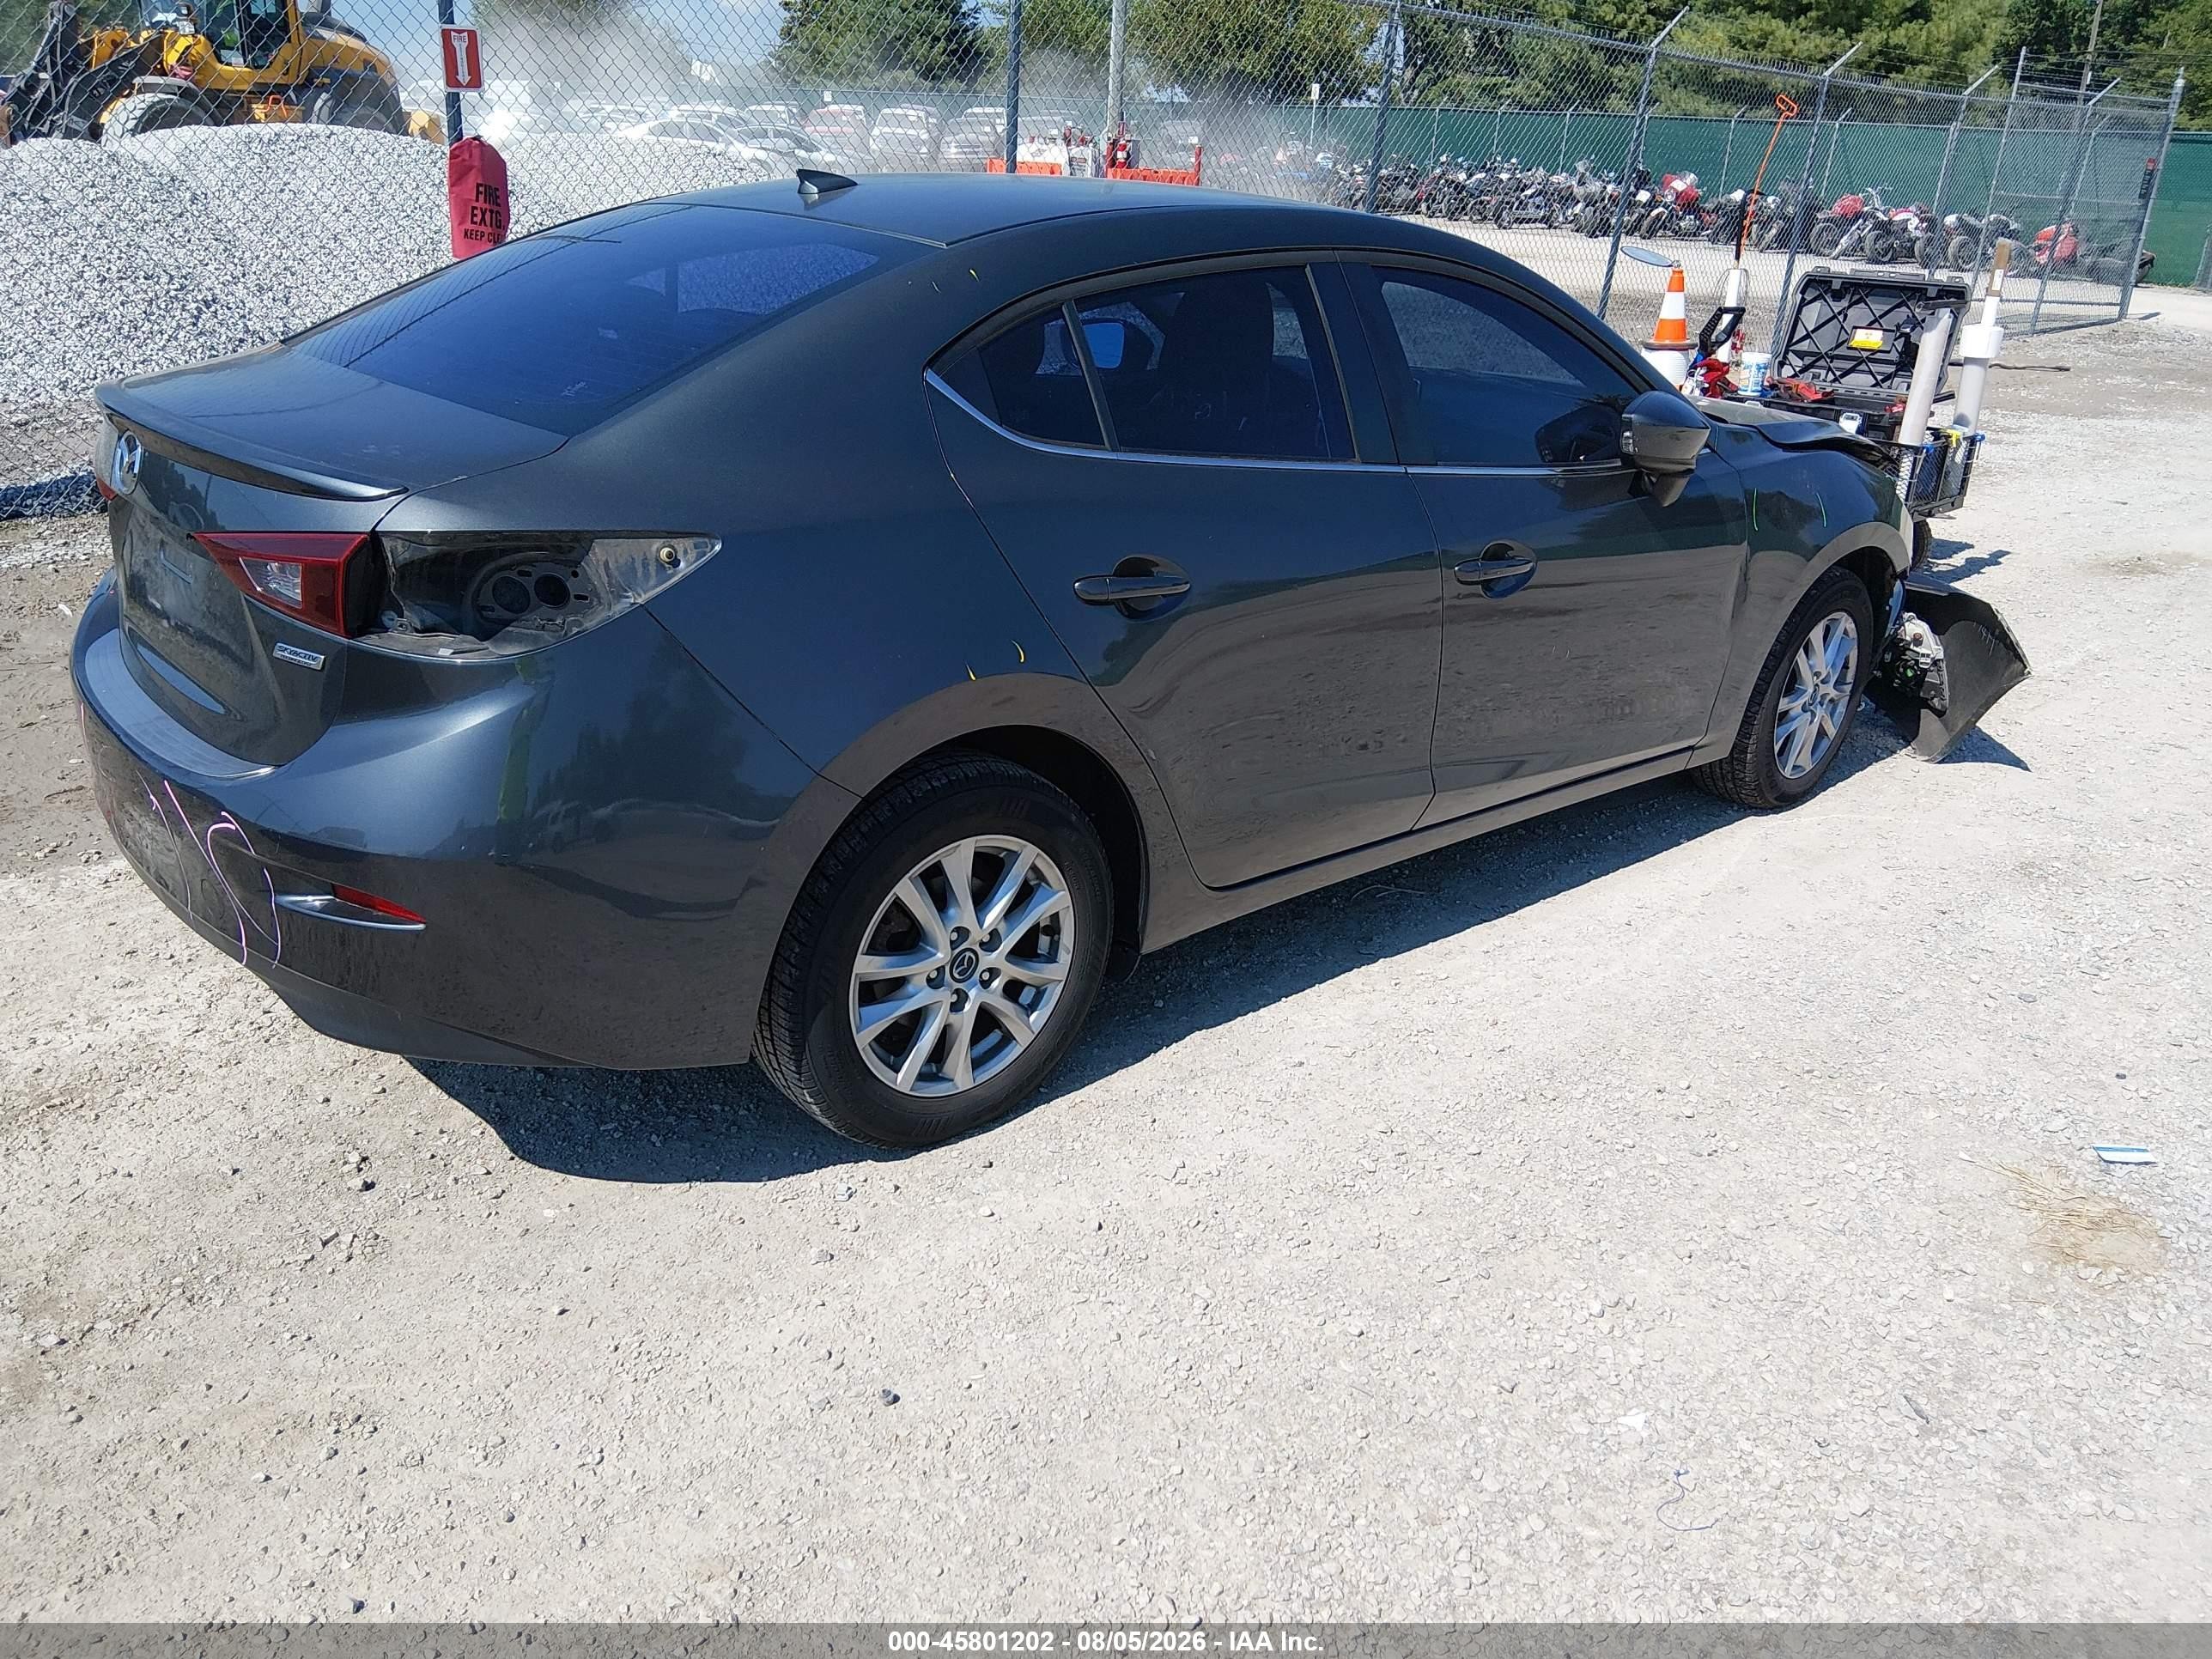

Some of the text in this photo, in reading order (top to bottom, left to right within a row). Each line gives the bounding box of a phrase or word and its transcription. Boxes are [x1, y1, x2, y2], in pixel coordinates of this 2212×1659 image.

[475, 182, 501, 207] FIRE
[470, 206, 505, 230] EXTG.
[464, 228, 485, 241] KEEP
